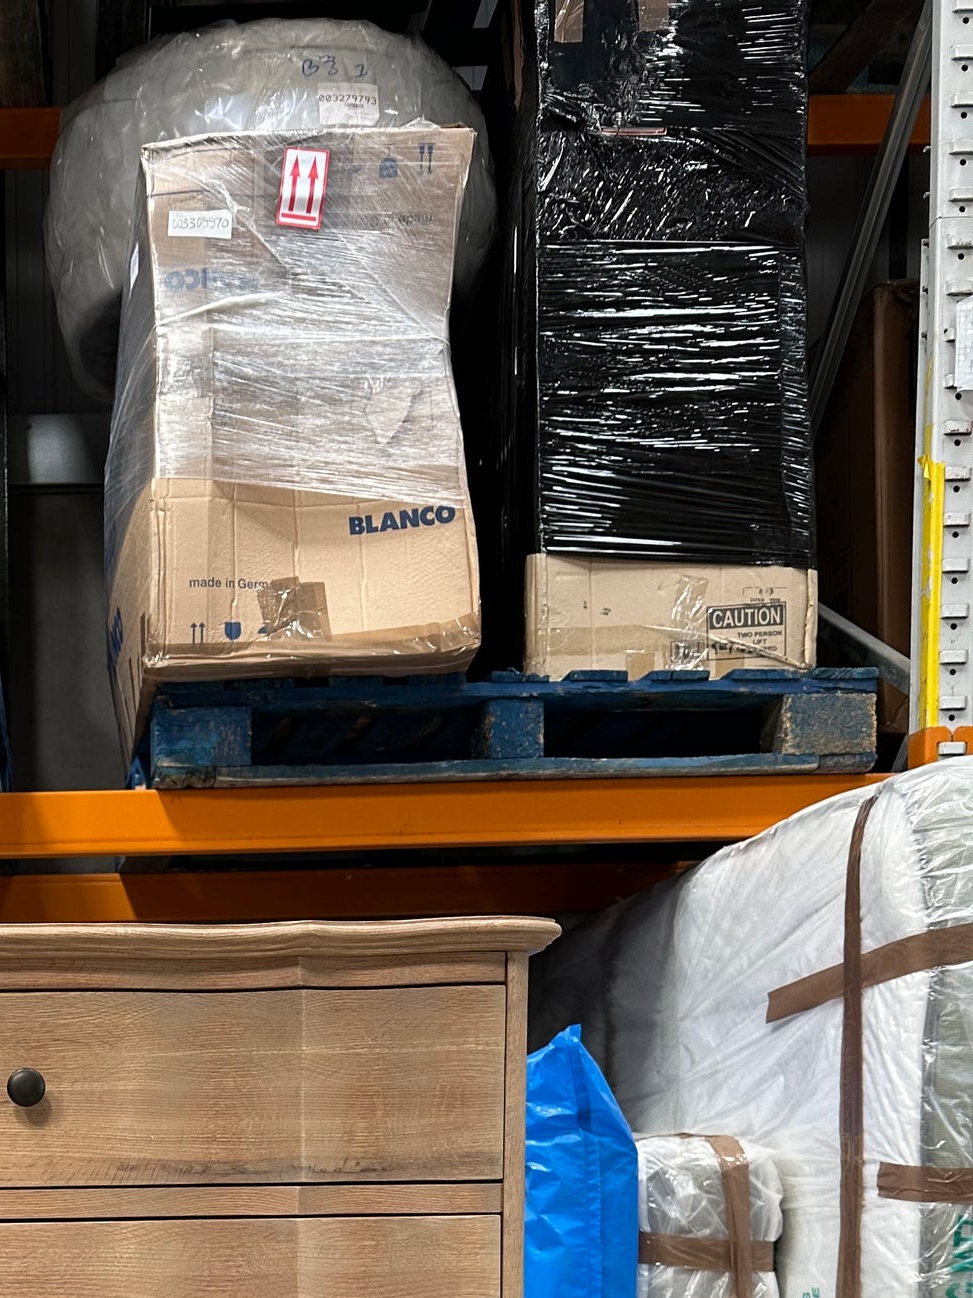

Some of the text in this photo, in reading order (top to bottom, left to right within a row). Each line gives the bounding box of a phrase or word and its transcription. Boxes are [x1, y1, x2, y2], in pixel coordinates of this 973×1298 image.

[318, 94, 377, 105] 003279793
[349, 505, 456, 535] BLANCO
[189, 577, 272, 590] made in Germ
[712, 606, 781, 628] CAUTION
[754, 630, 782, 638] PERSON
